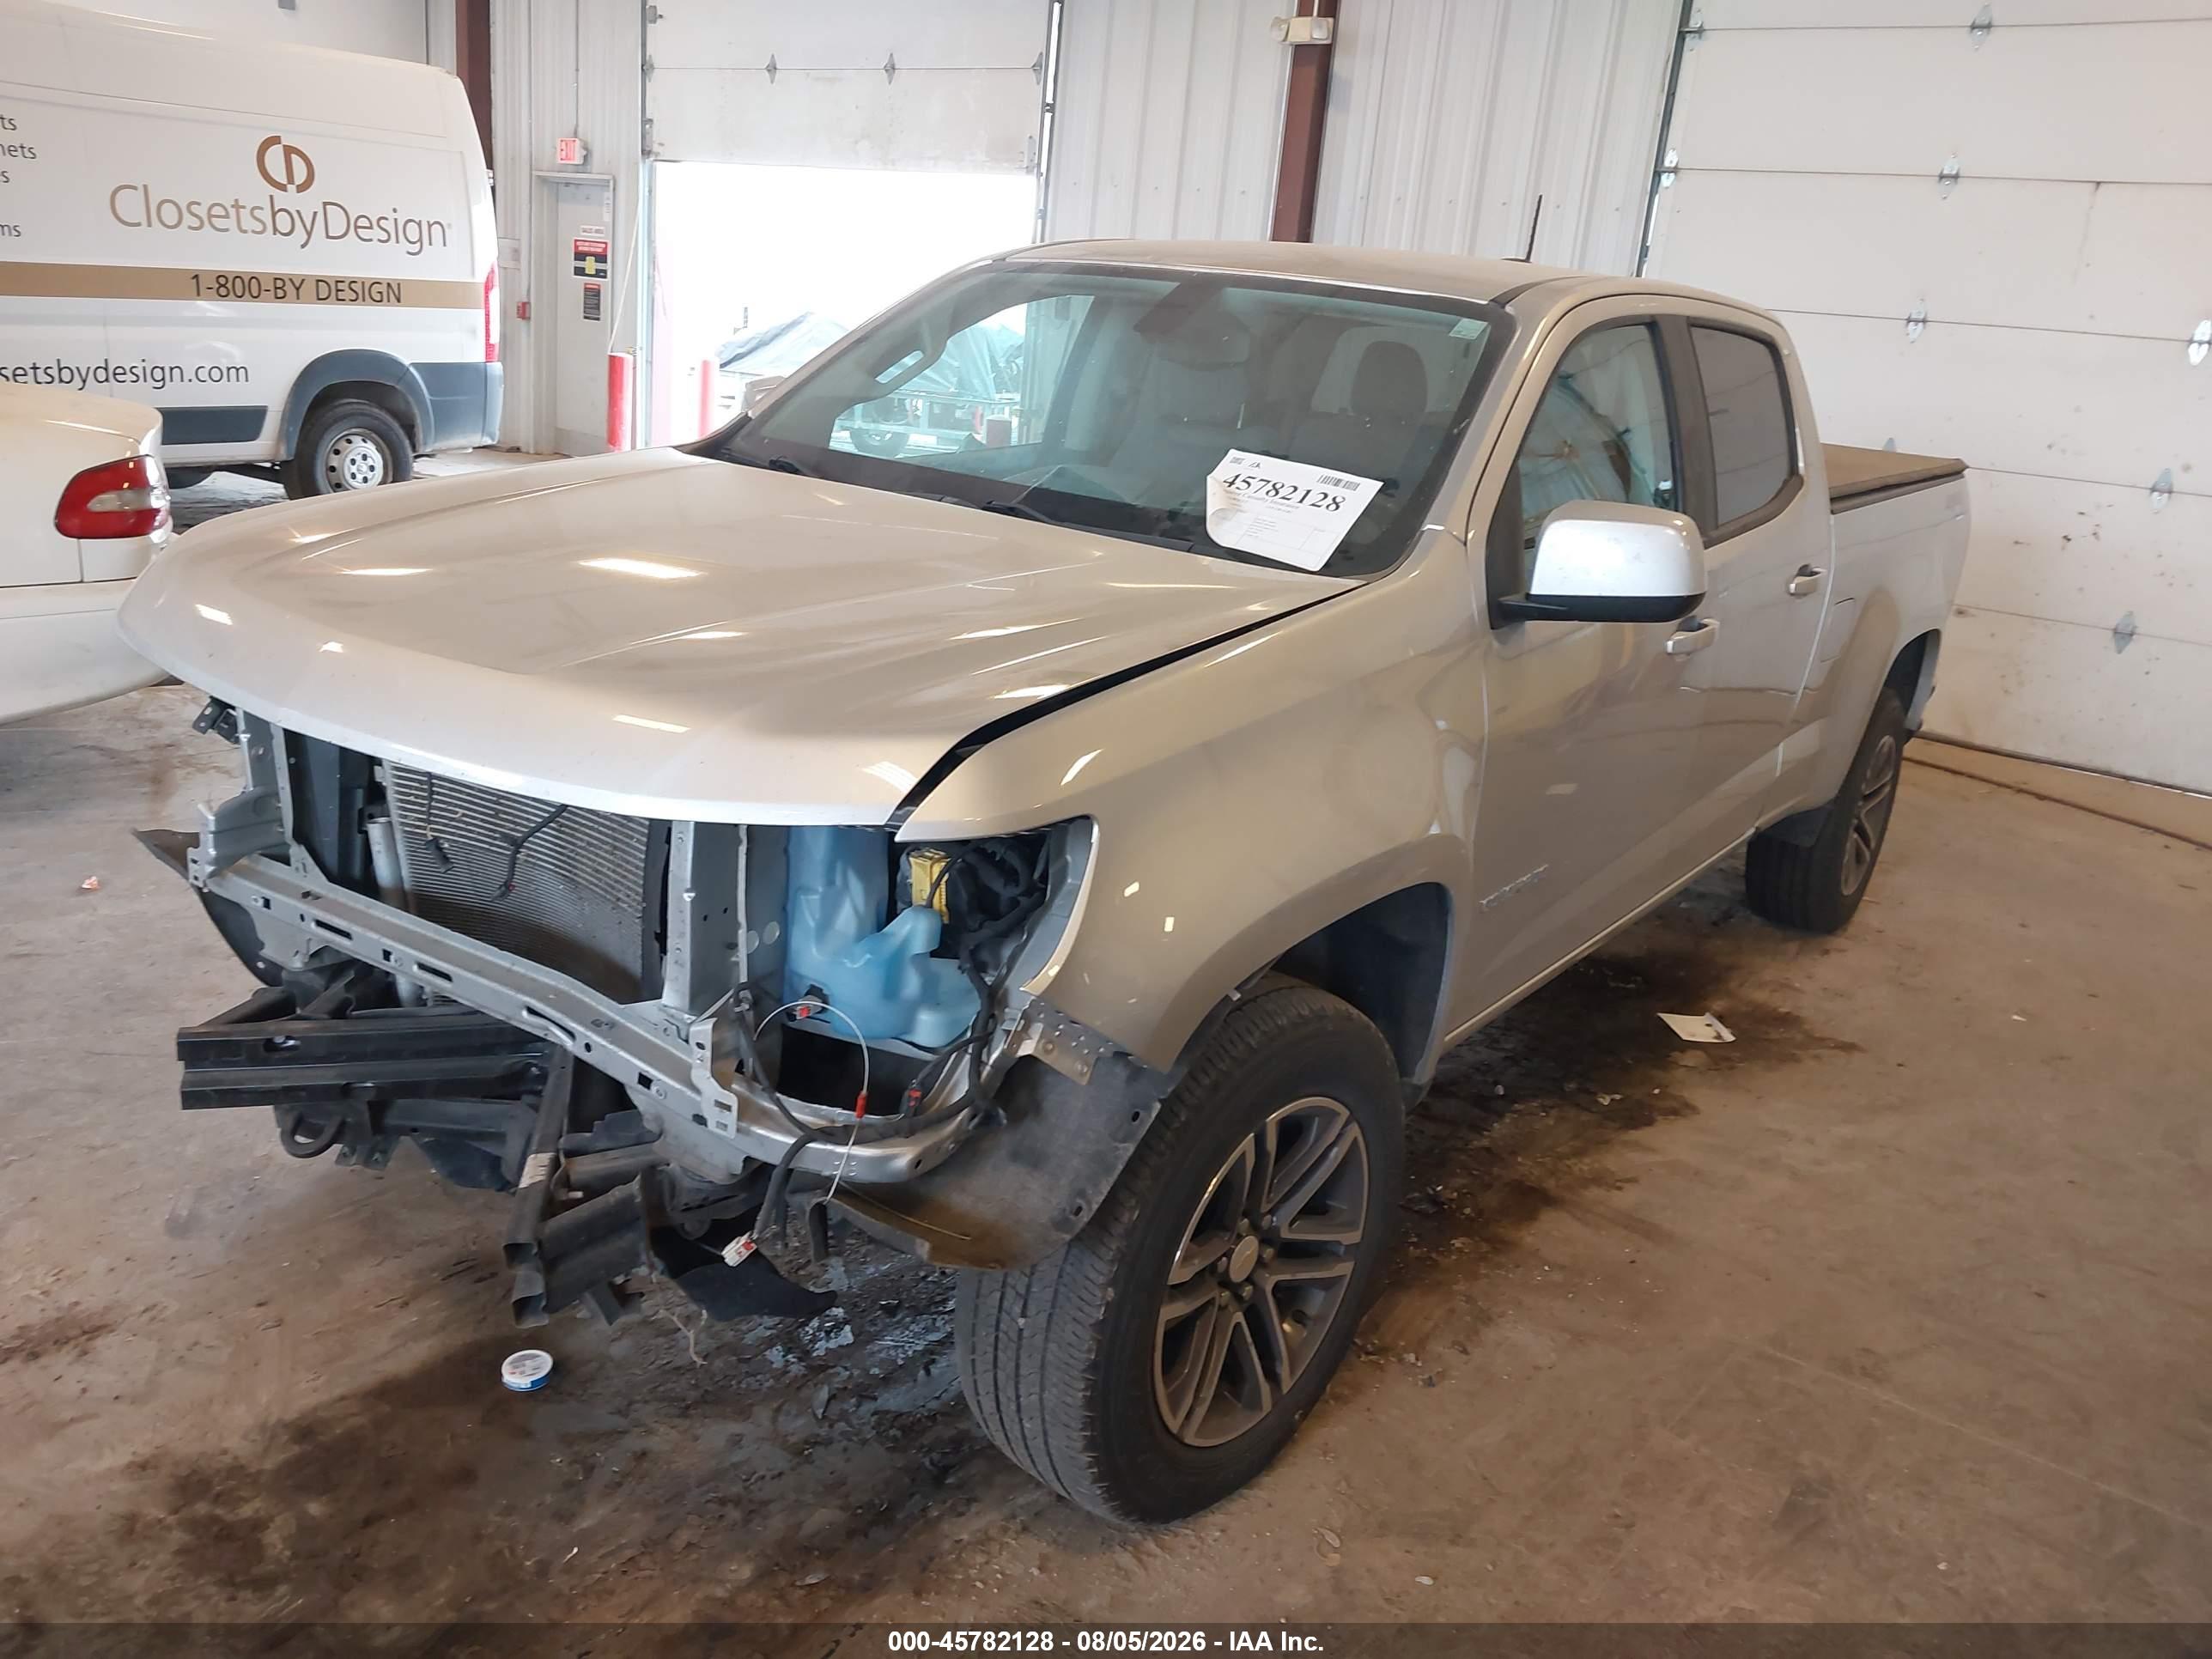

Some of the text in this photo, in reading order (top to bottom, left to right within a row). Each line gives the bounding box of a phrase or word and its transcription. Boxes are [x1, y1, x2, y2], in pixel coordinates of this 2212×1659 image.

[190, 273, 402, 304] 1-800-BY DESIGN
[1222, 473, 1346, 513] 45782128
